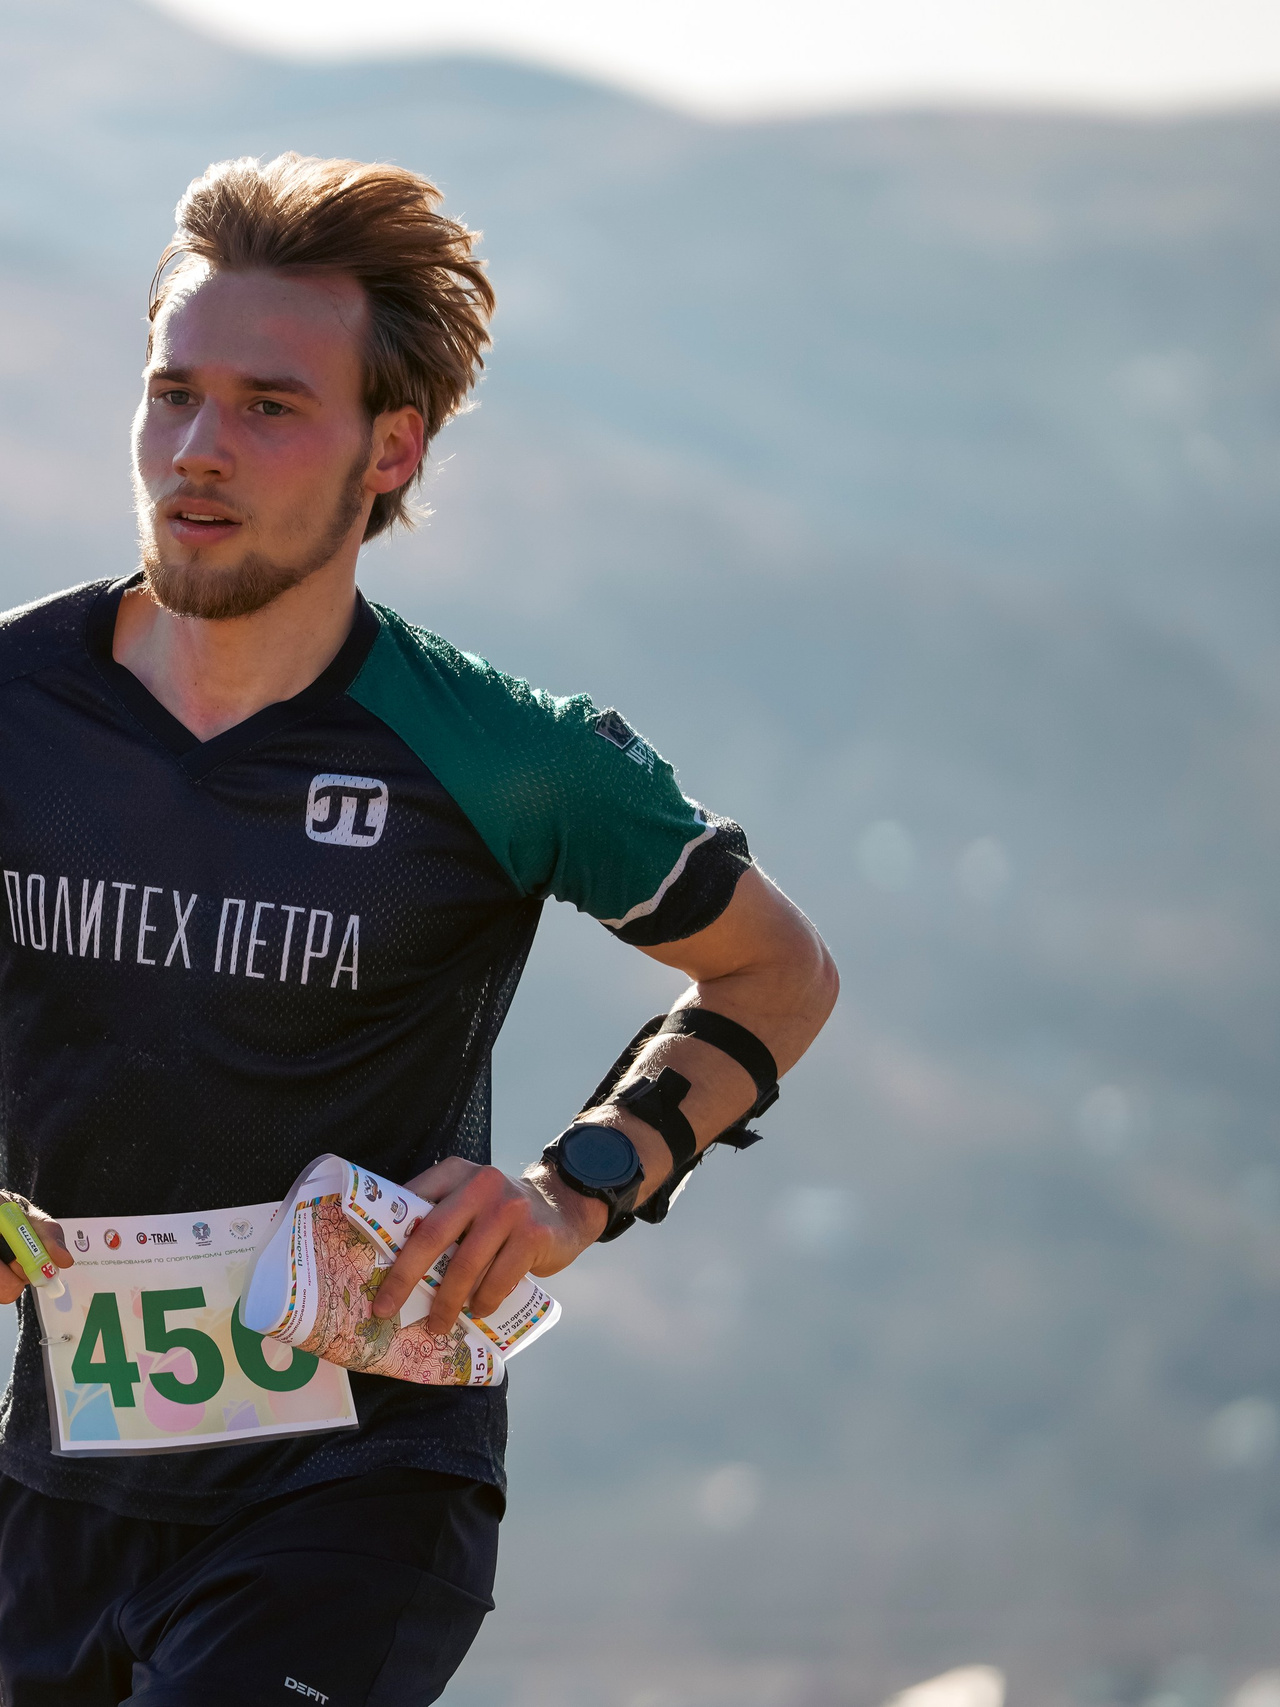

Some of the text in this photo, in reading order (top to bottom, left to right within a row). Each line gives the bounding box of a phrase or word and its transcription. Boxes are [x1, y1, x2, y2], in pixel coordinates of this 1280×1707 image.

[3, 870, 361, 990] ПОЛИТЕХ ПЕТРА
[101, 1258, 152, 1266] СОРЕВНОВАНИЯ
[166, 1252, 222, 1263] СПОРТИВНОМУ
[503, 1328, 511, 1336] +7
[511, 1319, 523, 1330] 928
[522, 1308, 533, 1320] 367
[533, 1300, 540, 1309] 11
[476, 1363, 486, 1371] 5
[284, 1676, 329, 1705] DEFIT
